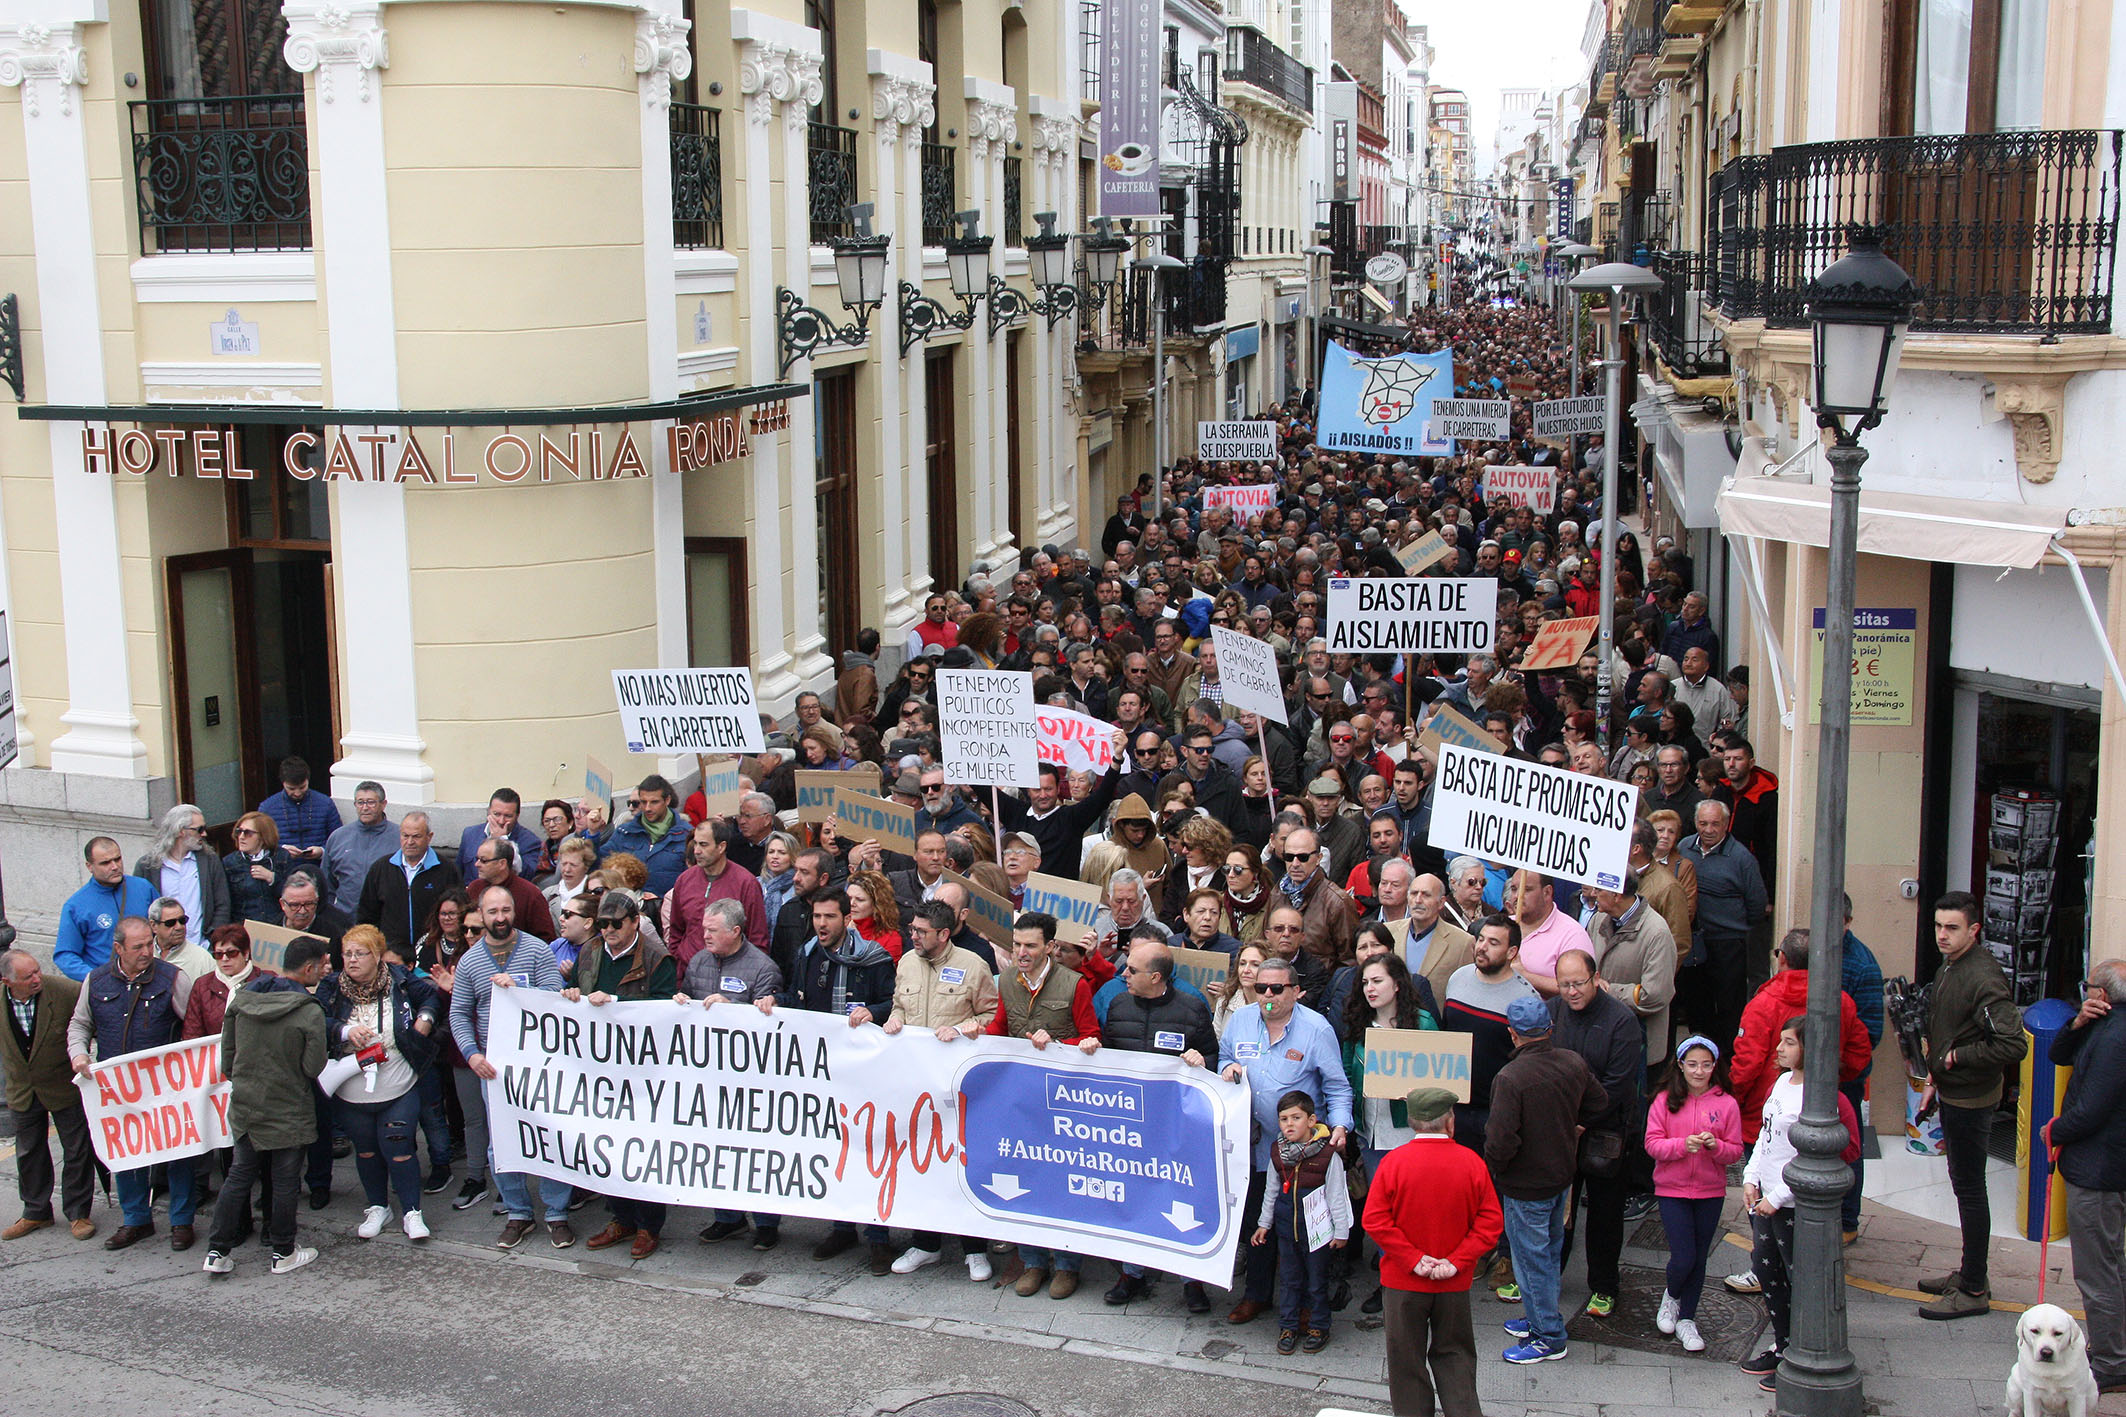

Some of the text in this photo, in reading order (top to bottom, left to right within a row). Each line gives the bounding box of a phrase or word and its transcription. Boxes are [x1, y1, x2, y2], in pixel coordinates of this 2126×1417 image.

[1111, 7, 1120, 132] ELADERIA
[1140, 3, 1149, 133] OGURTERIA
[1335, 123, 1346, 177] TORO
[1104, 181, 1155, 193] CAFETERIA
[1433, 401, 1508, 419] TENEMOS UNA MIERDA
[1535, 398, 1605, 418] POR EL FUTURO DE
[1205, 424, 1217, 439] LA
[1443, 421, 1497, 438] DE CARRETERAS
[1537, 416, 1603, 435] NUESTROS HIJOS
[82, 413, 750, 485] HOTEL CATALONIA RONDA
[1201, 443, 1274, 458] SE DESPUEBLA
[1340, 432, 1402, 450] AISLADOS
[1489, 471, 1550, 489] AUTOVIA
[1208, 489, 1271, 508] AUTOVIA
[1535, 490, 1551, 509] YA
[1358, 582, 1468, 612] BASTA DE
[1543, 617, 1596, 635] AUTOVIA
[1853, 612, 1890, 626] sitas
[1217, 629, 1268, 659] TENEMOS
[1332, 620, 1488, 649] AISLAMIENTO
[1222, 649, 1266, 676] CAMINOS
[1527, 636, 1576, 667] YA
[1866, 659, 1880, 677] €
[617, 673, 750, 707] NO MAS MUERTOS
[945, 675, 1021, 694] TENEMOS
[1223, 666, 1279, 699] DE CABRAS
[1862, 688, 1899, 697] Viernes
[945, 696, 1015, 715] POLITICOS
[1863, 698, 1905, 710] Domingo
[639, 715, 748, 748] EN CARRETERA
[941, 718, 1037, 739] INCOMPETENTES
[959, 741, 1011, 759] RONDA
[1079, 739, 1112, 767] YA
[947, 761, 1017, 782] SE MUERE
[1442, 751, 1630, 832] BASTA DE PROMESAS
[837, 799, 915, 841] AUTOVIA
[1464, 809, 1591, 877] INCUMPLIDAS
[517, 1007, 832, 1082] POR UNA AUTOVÍA A
[1364, 1049, 1471, 1081] AUTOVIA
[502, 1056, 842, 1141] MÁLAGA Y LA MEJORA
[1053, 1084, 1137, 1111] Autovía
[100, 1092, 229, 1160] RONDA Y
[1053, 1115, 1143, 1149] Ronda
[517, 1118, 830, 1200] DE LAS CARRETERAS
[997, 1136, 1195, 1188] #AutoviaRondaYA
